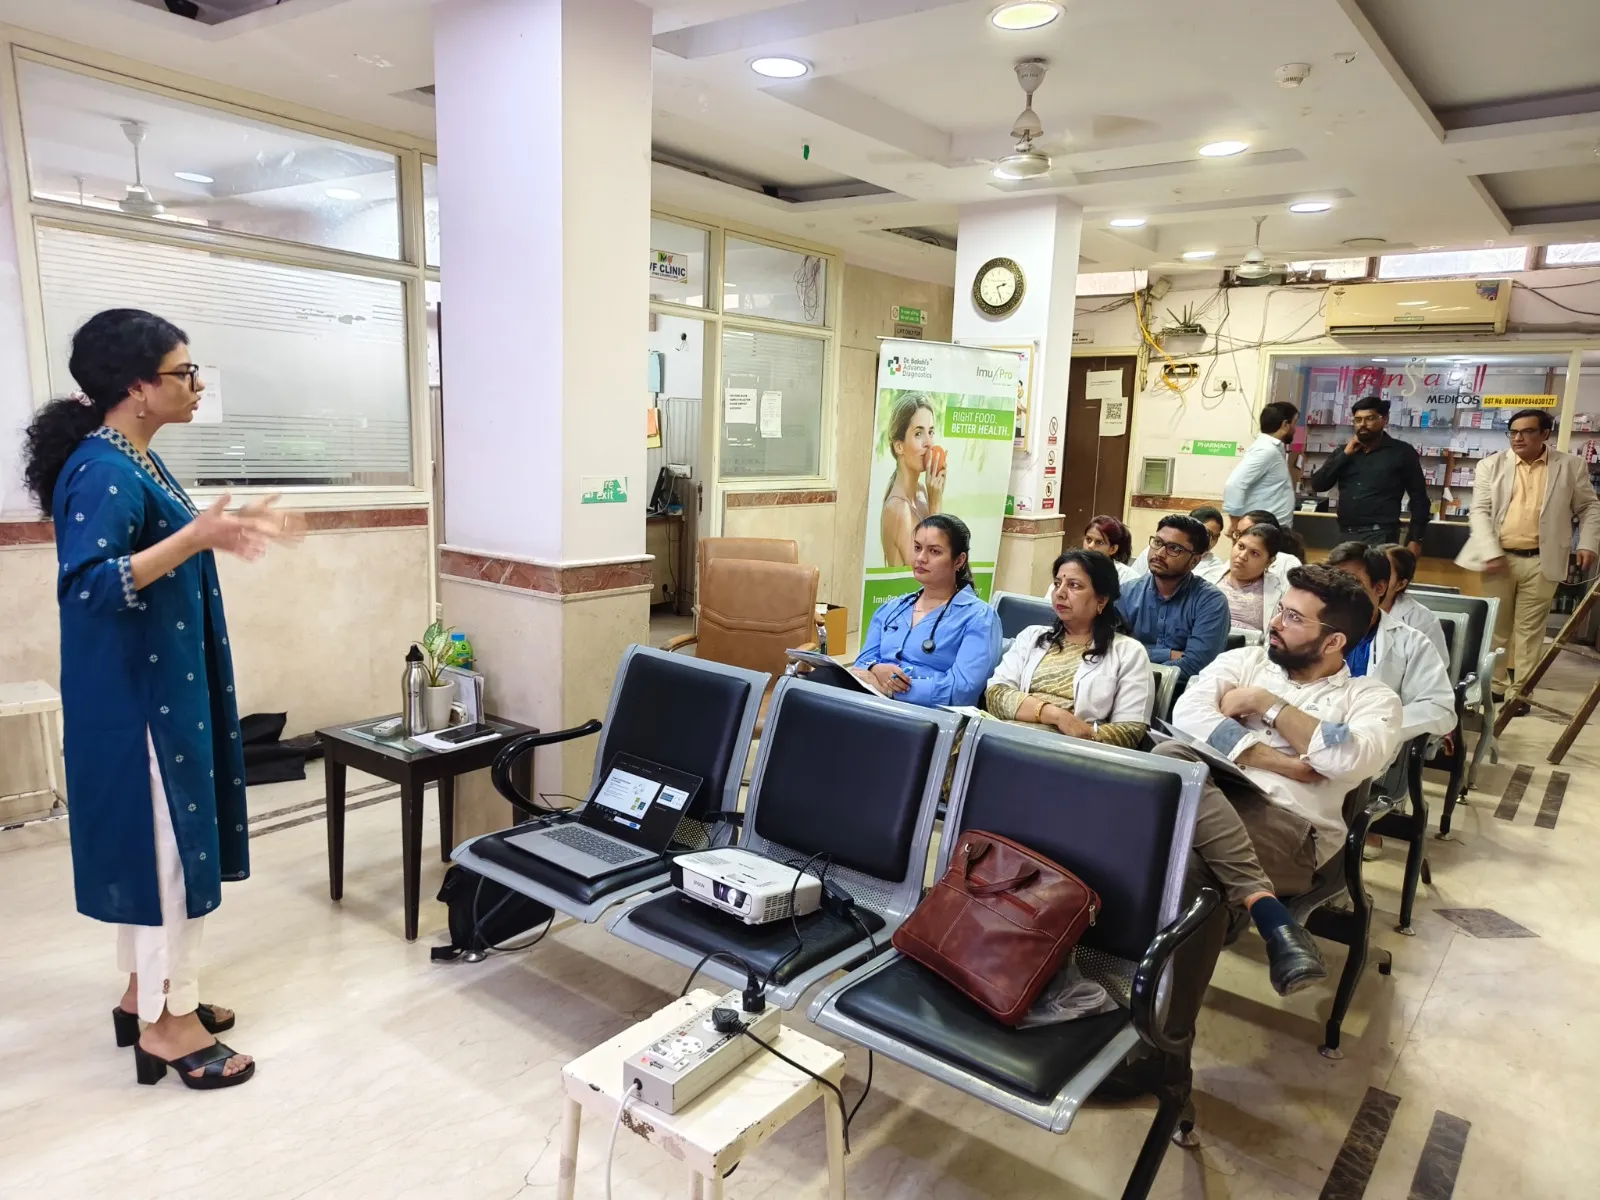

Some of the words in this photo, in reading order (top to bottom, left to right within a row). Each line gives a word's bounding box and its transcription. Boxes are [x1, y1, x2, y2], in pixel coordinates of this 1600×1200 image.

[659, 264, 686, 277] CLINIC
[903, 364, 926, 372] Advance
[902, 370, 932, 379] Diagnostics
[1426, 395, 1480, 405] MEDICOS
[952, 411, 974, 422] RIGHT
[975, 412, 998, 424] FOOD.
[951, 423, 977, 434] BETTER
[978, 424, 1010, 436] HEALTH.
